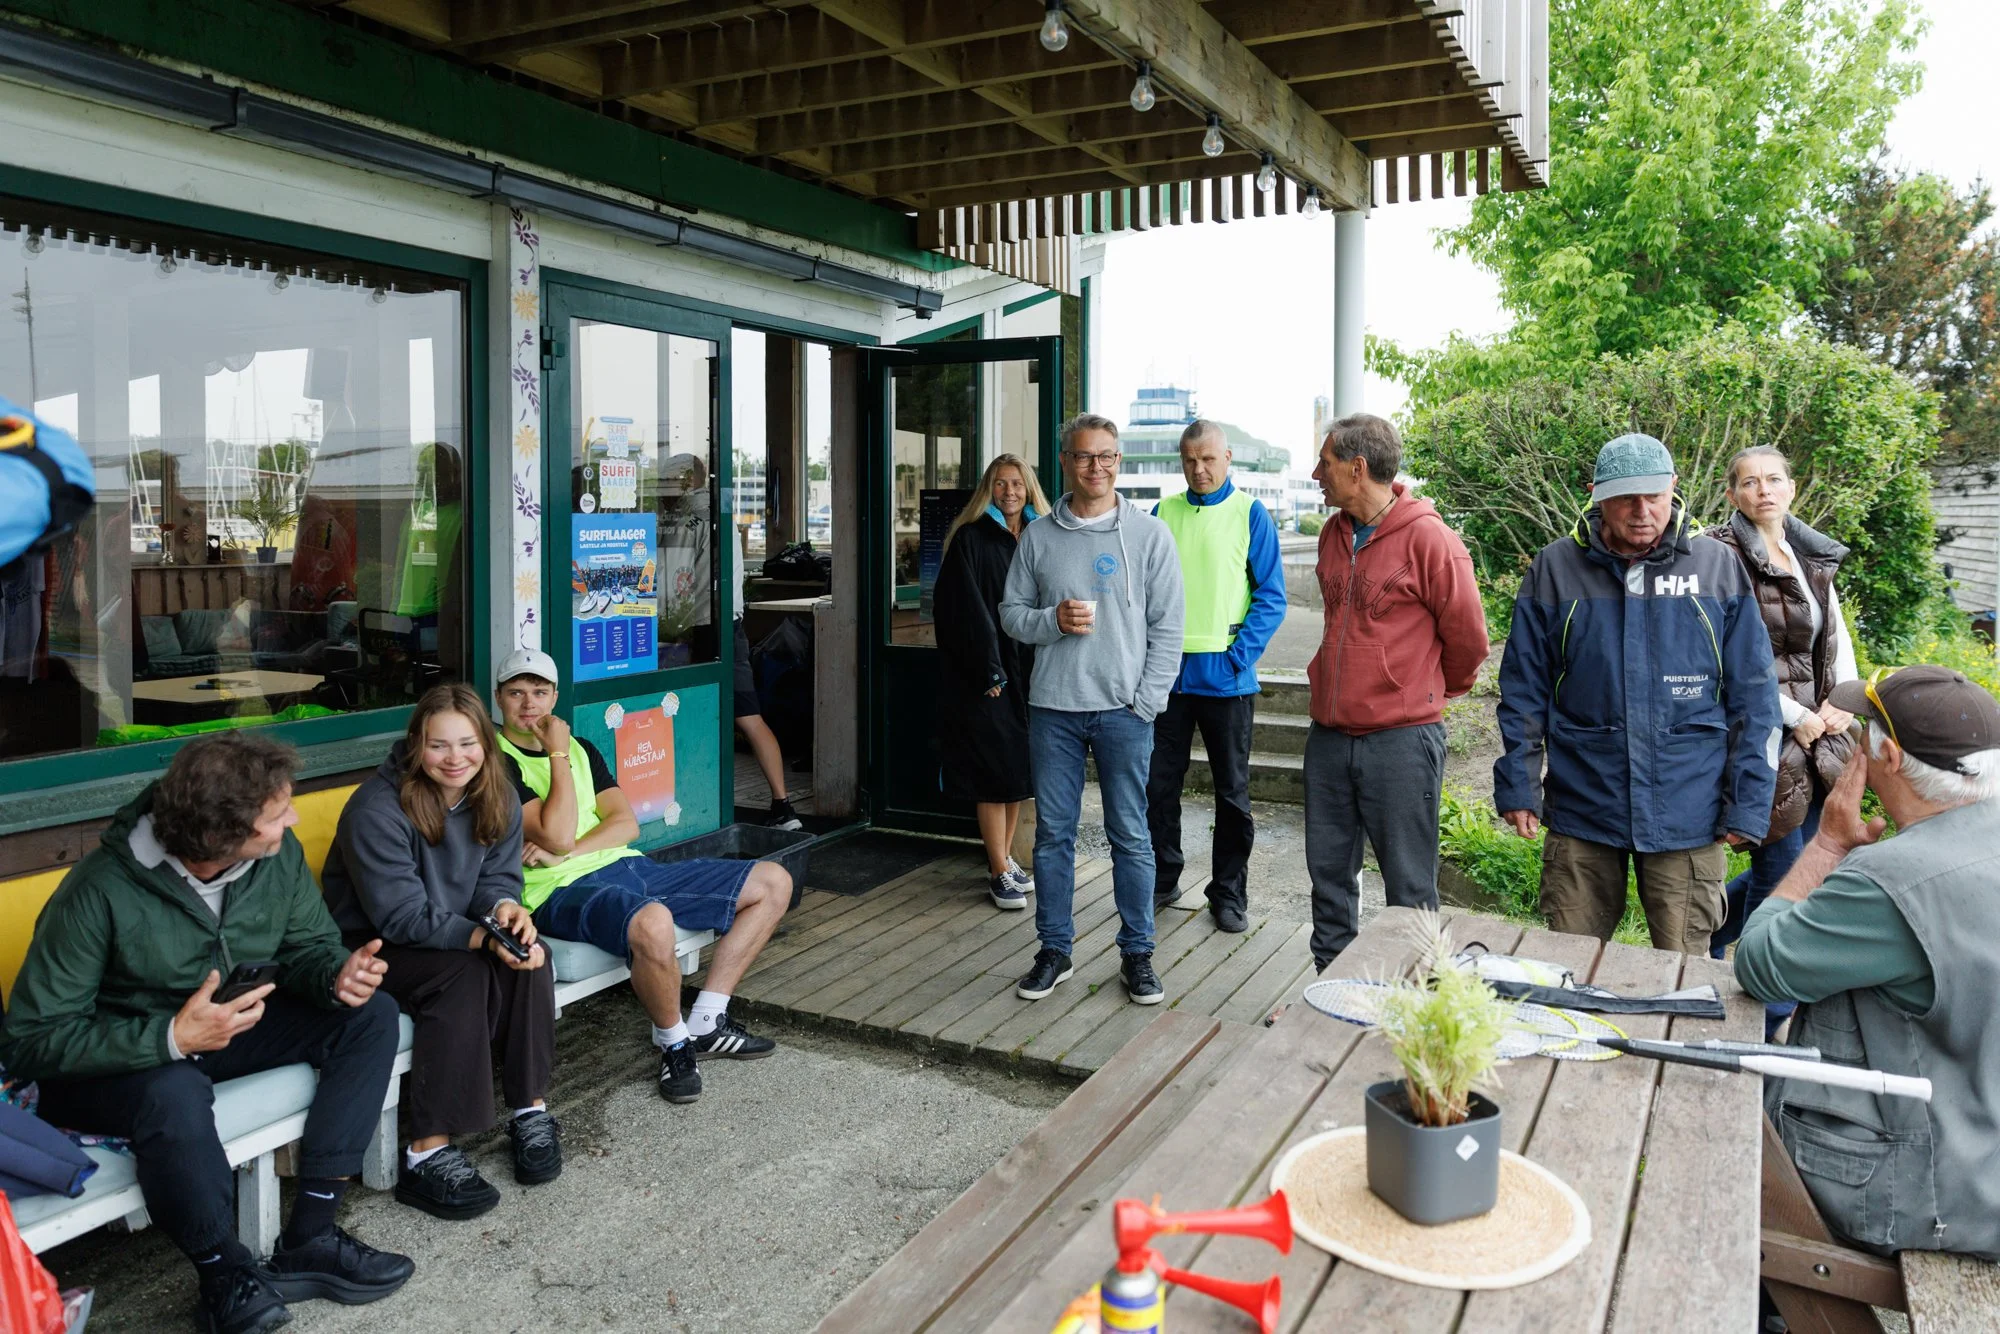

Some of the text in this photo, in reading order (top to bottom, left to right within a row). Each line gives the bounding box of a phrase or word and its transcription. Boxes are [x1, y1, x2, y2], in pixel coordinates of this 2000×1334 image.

[601, 465, 635, 476] SURFI
[579, 529, 646, 541] SURFILAAGER
[1655, 574, 1699, 595] HH
[1663, 674, 1709, 683] PUISTEVILLA
[637, 740, 652, 753] HEA
[623, 748, 666, 768] KÜLASTAJA
